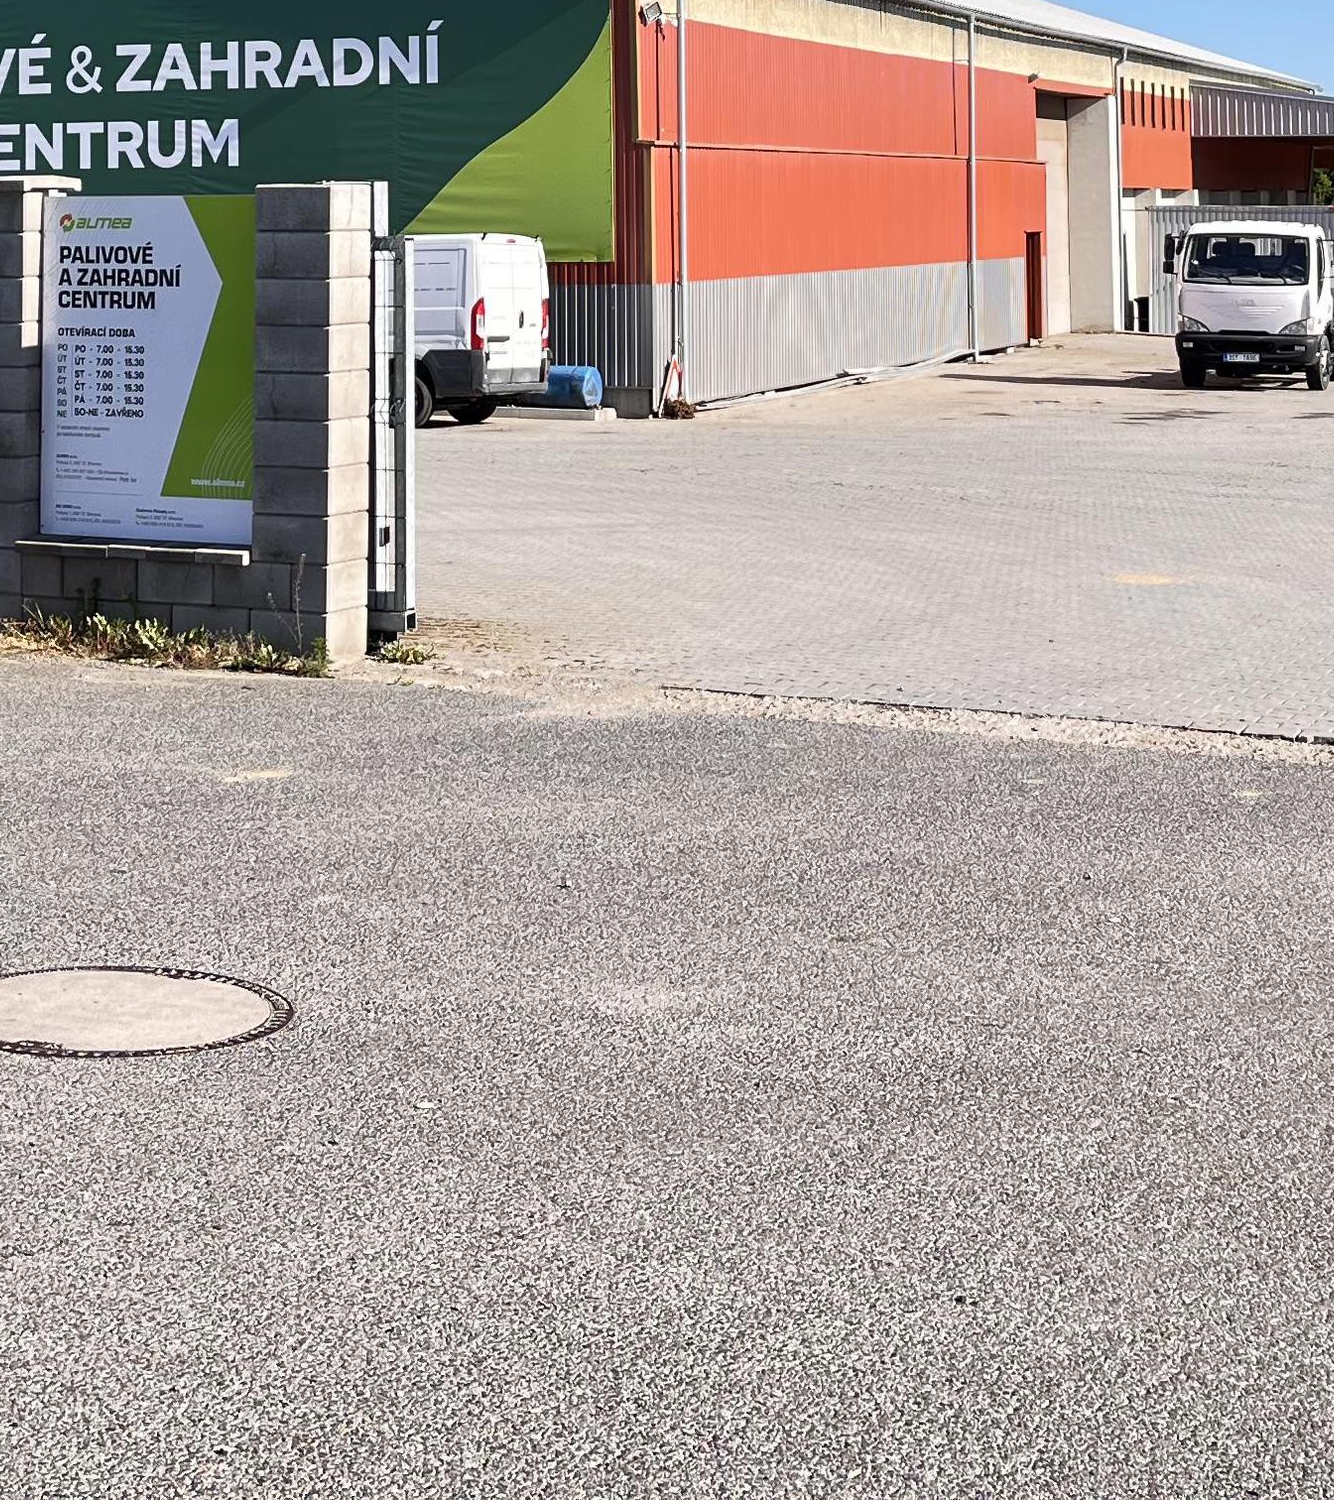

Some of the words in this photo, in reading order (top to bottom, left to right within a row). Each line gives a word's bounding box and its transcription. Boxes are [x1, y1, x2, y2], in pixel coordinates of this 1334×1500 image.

[66, 46, 103, 94] &
[115, 20, 444, 93] ZAHRADNÍ
[59, 241, 153, 264] PALIVOVÉ
[58, 268, 72, 286] A
[76, 264, 181, 287] ZAHRADNÍ
[58, 290, 156, 309] CENTRUM
[58, 326, 106, 337] OTEVÍRACÍ
[109, 328, 135, 337] DOBA
[75, 345, 86, 353] PO
[96, 345, 114, 353] 7.00
[75, 356, 85, 365] ÚT
[96, 358, 113, 366] 7.00
[75, 370, 85, 378] ST
[96, 370, 113, 379] 7.00
[75, 380, 86, 390] ČT
[96, 383, 113, 391] 7.00
[75, 394, 86, 403] PÁ
[96, 396, 113, 404] 7.00
[105, 407, 144, 418] ZAVŘENO
